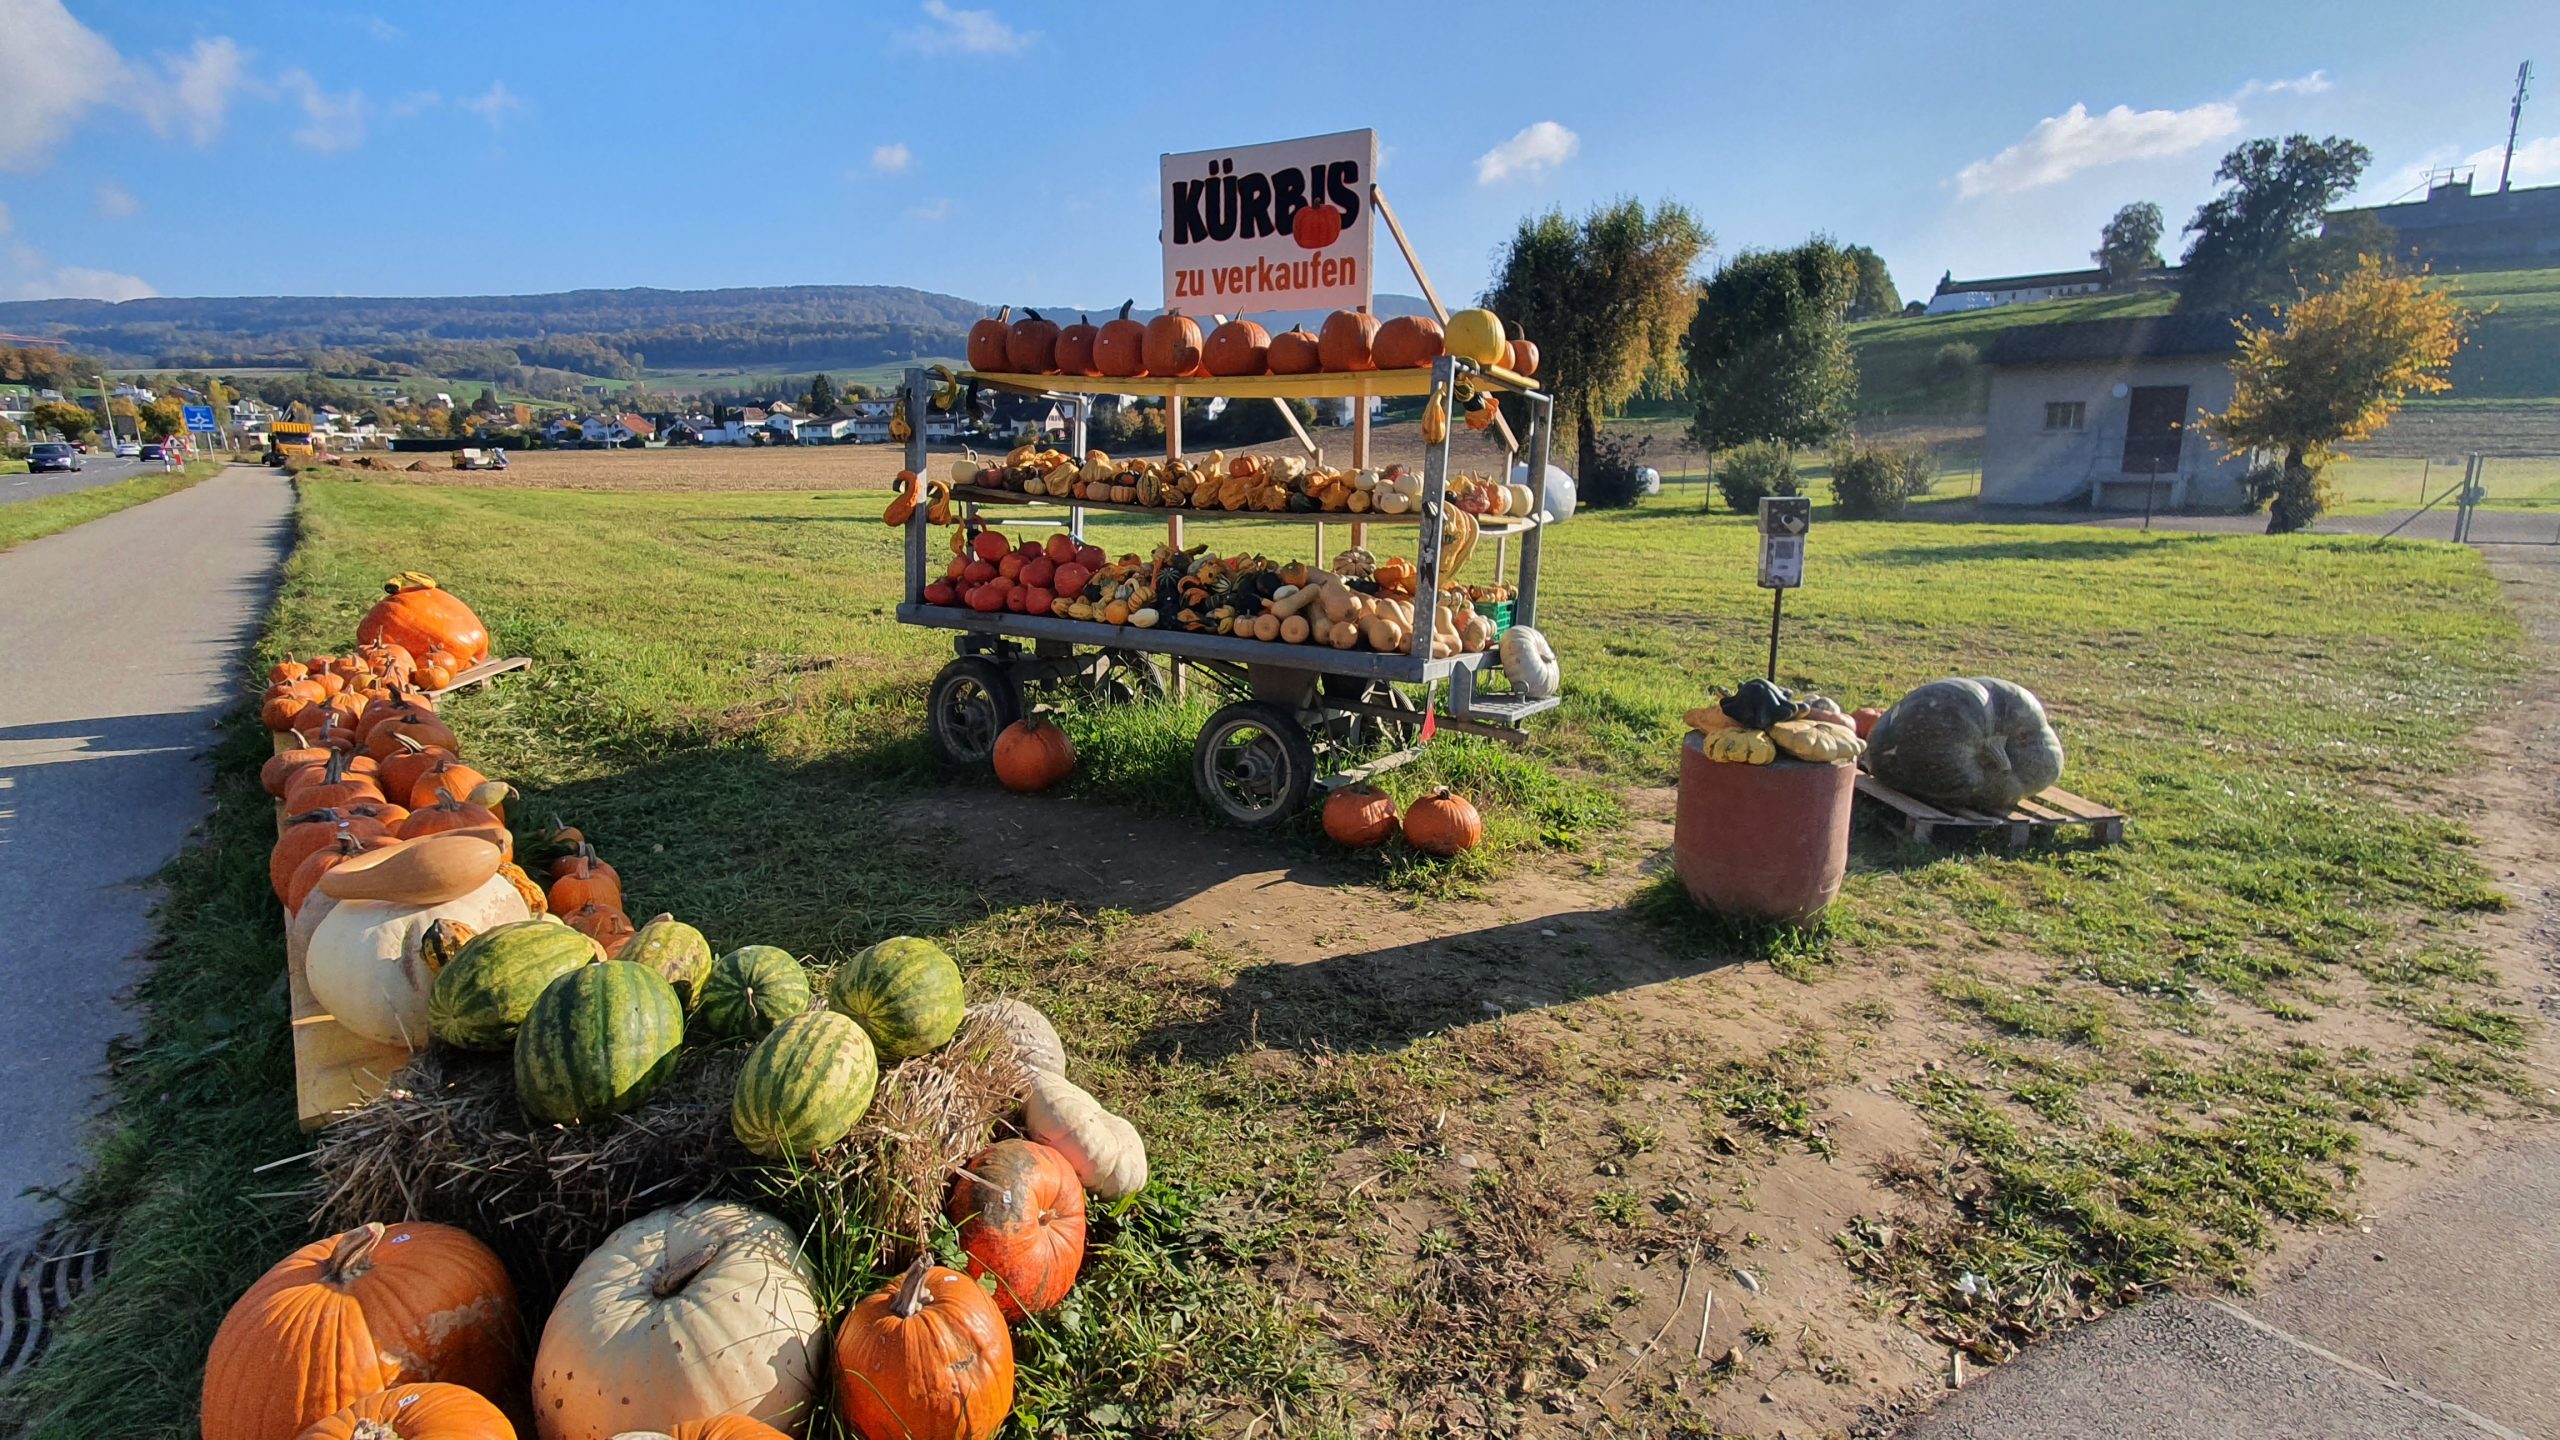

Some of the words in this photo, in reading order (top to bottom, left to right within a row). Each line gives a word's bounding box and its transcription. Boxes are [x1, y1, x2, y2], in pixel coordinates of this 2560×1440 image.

[1172, 158, 1360, 245] KÜRBIS
[1175, 270, 1204, 297] zu
[1212, 251, 1356, 295] verkaufen
